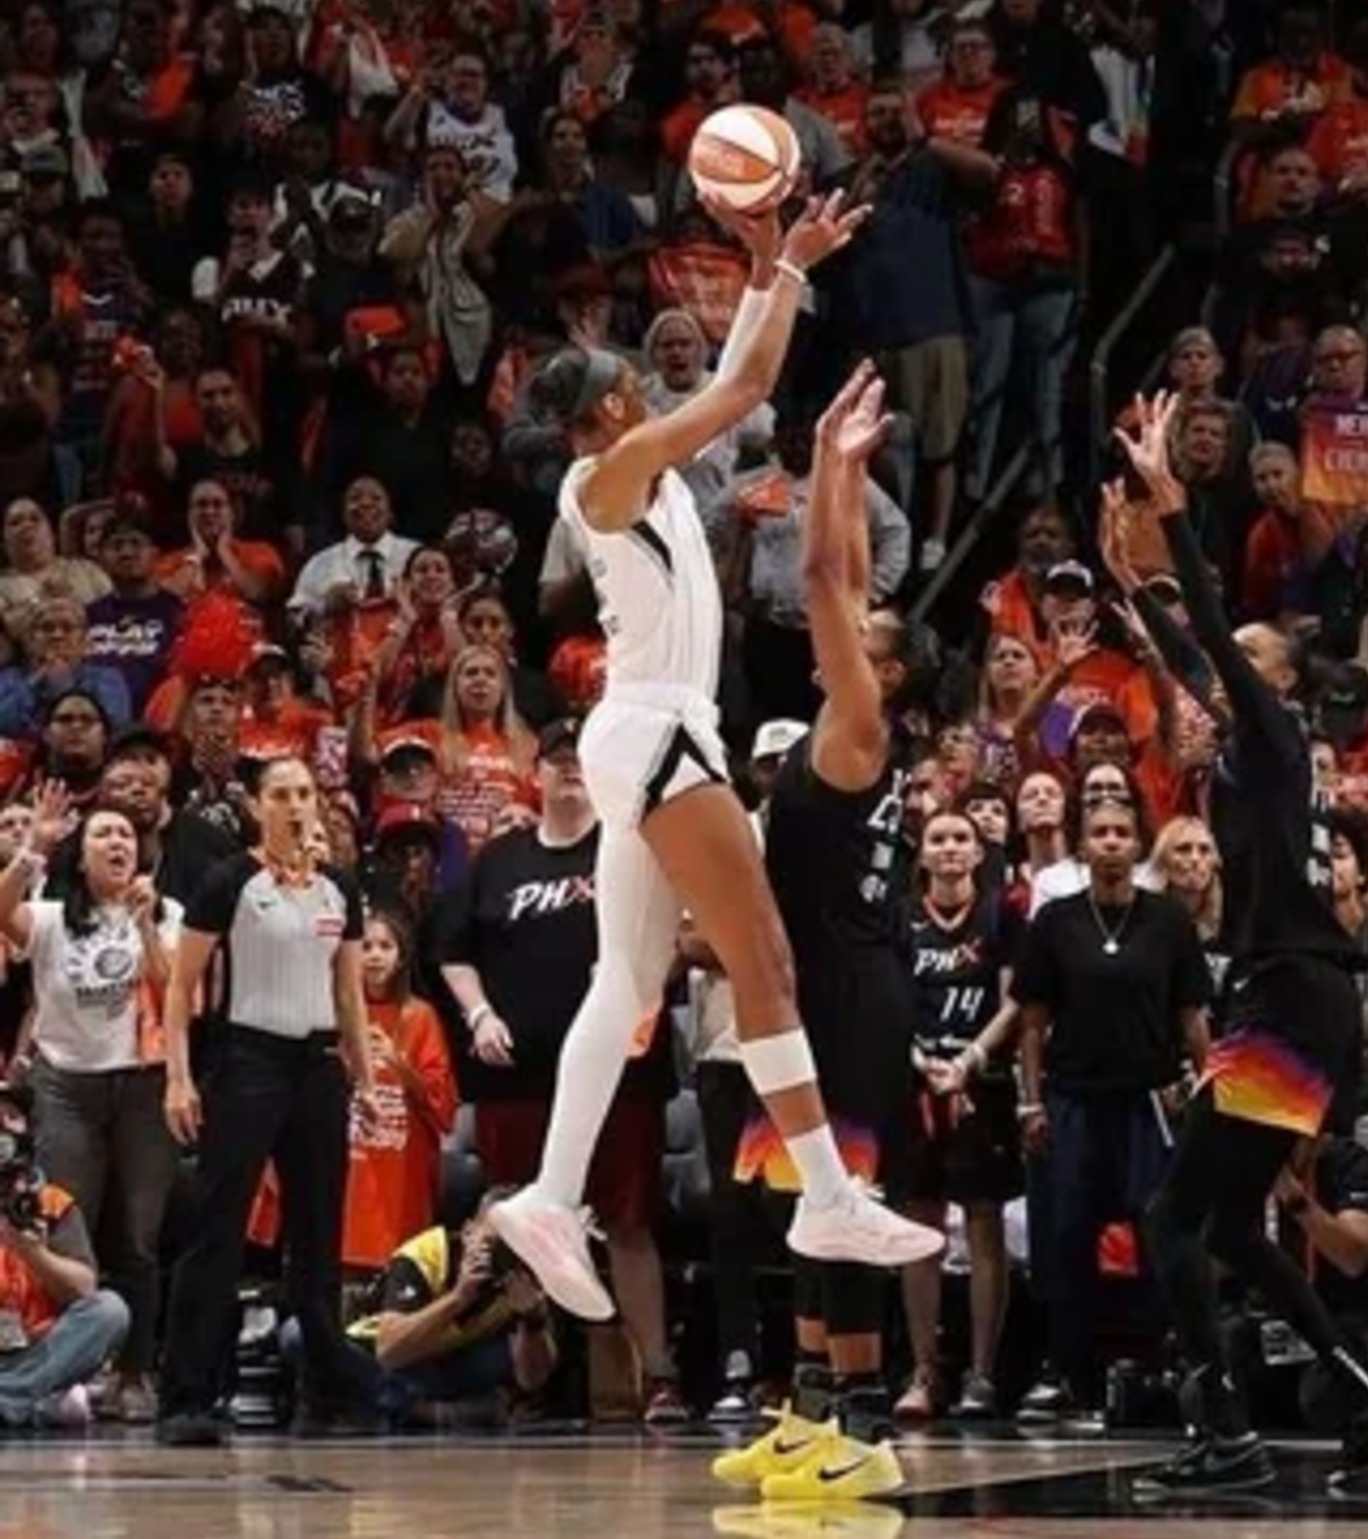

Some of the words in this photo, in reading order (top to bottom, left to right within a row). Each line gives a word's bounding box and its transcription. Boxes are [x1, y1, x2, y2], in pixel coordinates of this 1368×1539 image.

[508, 876, 596, 920] PHX
[914, 940, 981, 976] PHX
[941, 986, 985, 1021] 14
